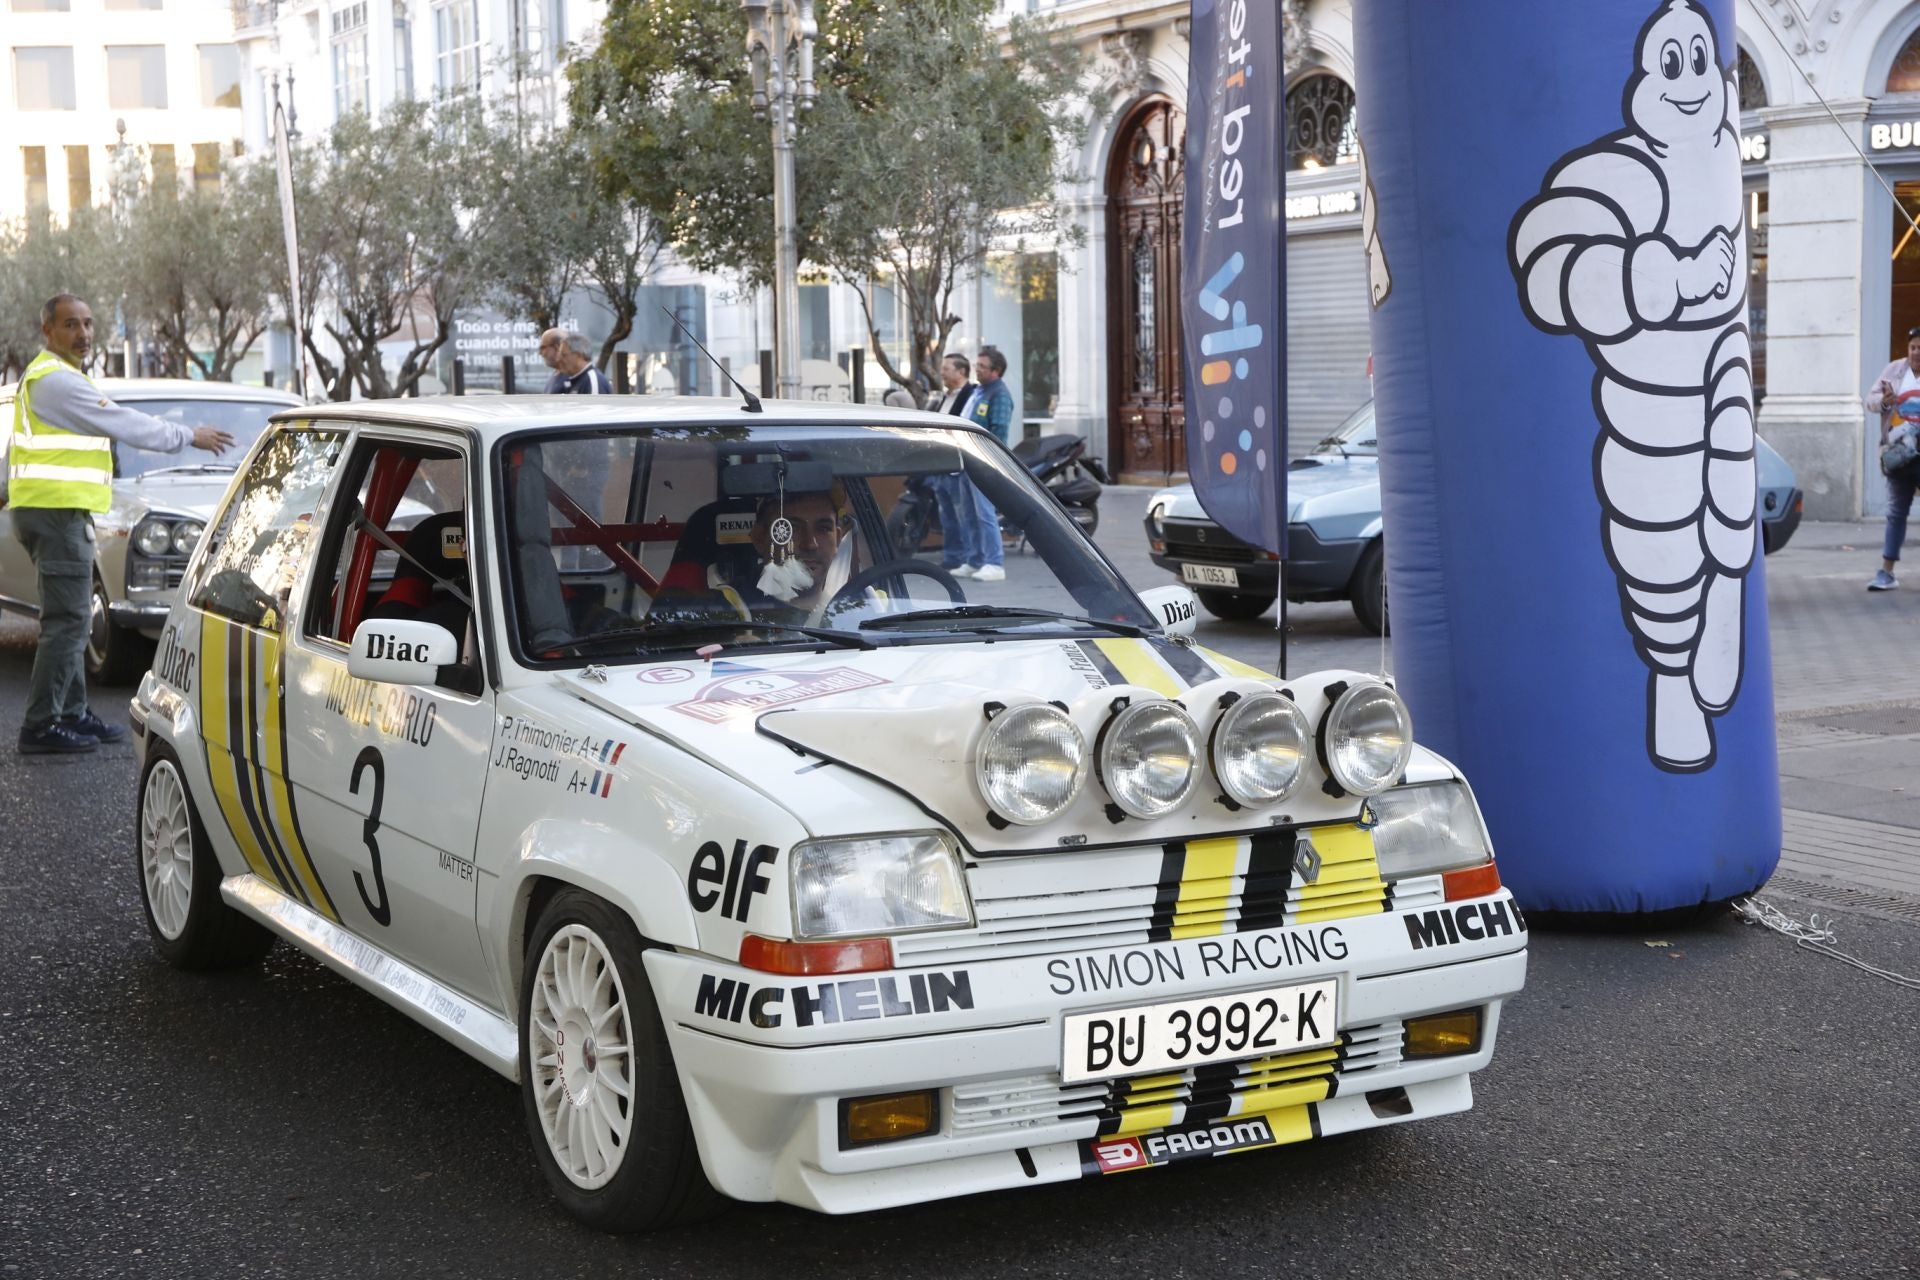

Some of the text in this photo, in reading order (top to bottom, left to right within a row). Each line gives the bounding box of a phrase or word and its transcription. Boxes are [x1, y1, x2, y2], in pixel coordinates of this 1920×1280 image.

[1320, 191, 1357, 214] KING
[455, 335, 509, 349] cuando
[493, 322, 511, 333] es
[473, 352, 521, 365] miso
[1184, 565, 1237, 584] VA 1053 J
[1162, 600, 1195, 626] Diac
[160, 624, 196, 694] Diac
[366, 633, 429, 663] Diac
[349, 745, 391, 927] 3
[438, 850, 473, 882] MATTER
[688, 838, 780, 923] elf
[1046, 926, 1349, 995] SIMON RACING
[423, 982, 467, 1025] France
[694, 970, 974, 1028] MICHELIN
[1086, 990, 1323, 1072] BU 3992 K
